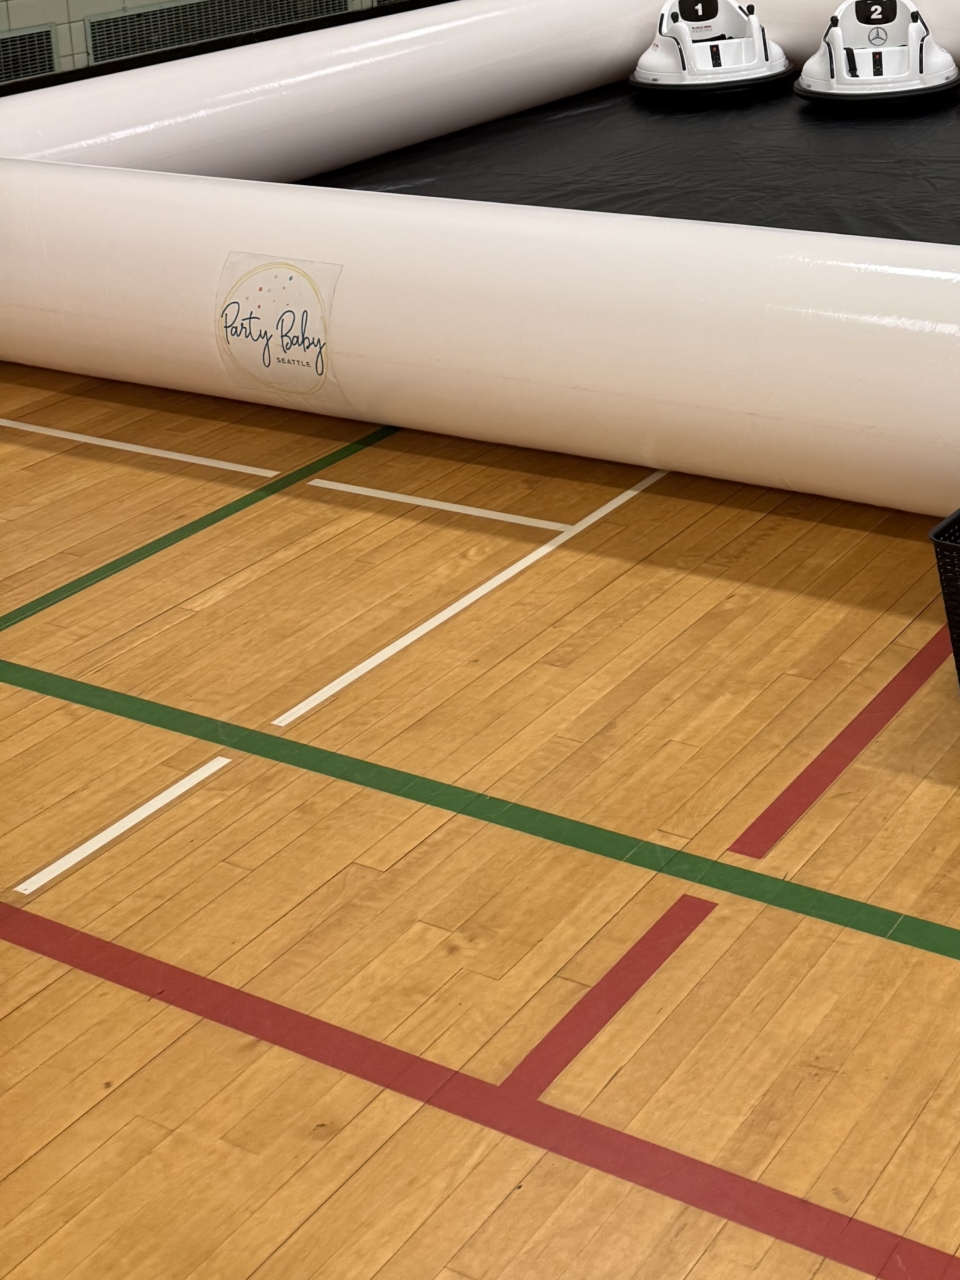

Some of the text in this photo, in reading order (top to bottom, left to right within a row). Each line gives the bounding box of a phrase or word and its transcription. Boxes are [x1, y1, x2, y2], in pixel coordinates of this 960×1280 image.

[694, 2, 703, 16] 1
[870, 4, 883, 19] 2
[221, 301, 327, 376] Party Baby
[276, 357, 311, 368] SEATTLE
